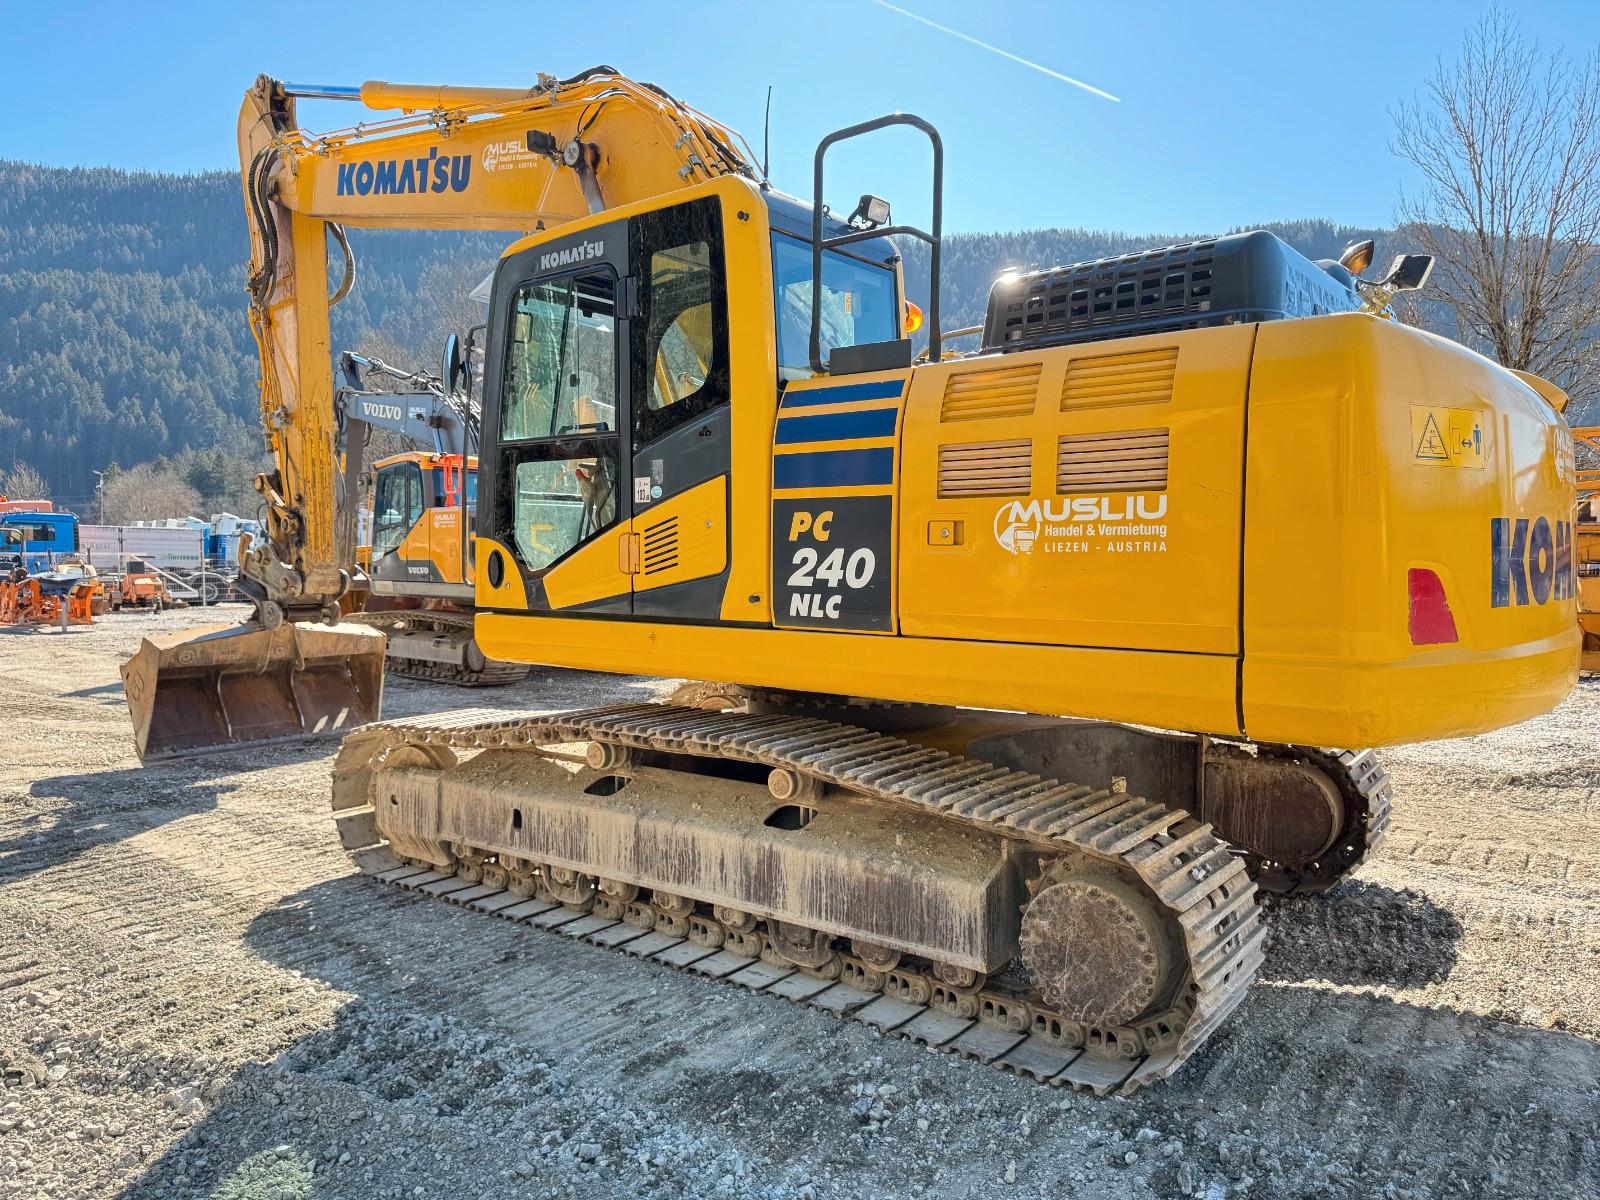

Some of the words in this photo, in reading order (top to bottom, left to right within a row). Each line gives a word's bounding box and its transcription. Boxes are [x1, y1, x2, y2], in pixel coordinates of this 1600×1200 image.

[337, 147, 471, 196] KOMATSU
[541, 240, 604, 270] KOMATSU
[363, 402, 402, 420] VOLVO
[1008, 495, 1168, 522] MUSLIU
[788, 511, 834, 541] PC
[1044, 524, 1083, 537] Handel
[1086, 525, 1096, 536] &
[1098, 523, 1168, 537] Vermietung
[1044, 542, 1089, 553] LIEZEN
[1107, 541, 1168, 553] AUSTRIA
[408, 566, 429, 574] VOLVO
[787, 547, 876, 589] 240
[789, 593, 843, 619] NLC
